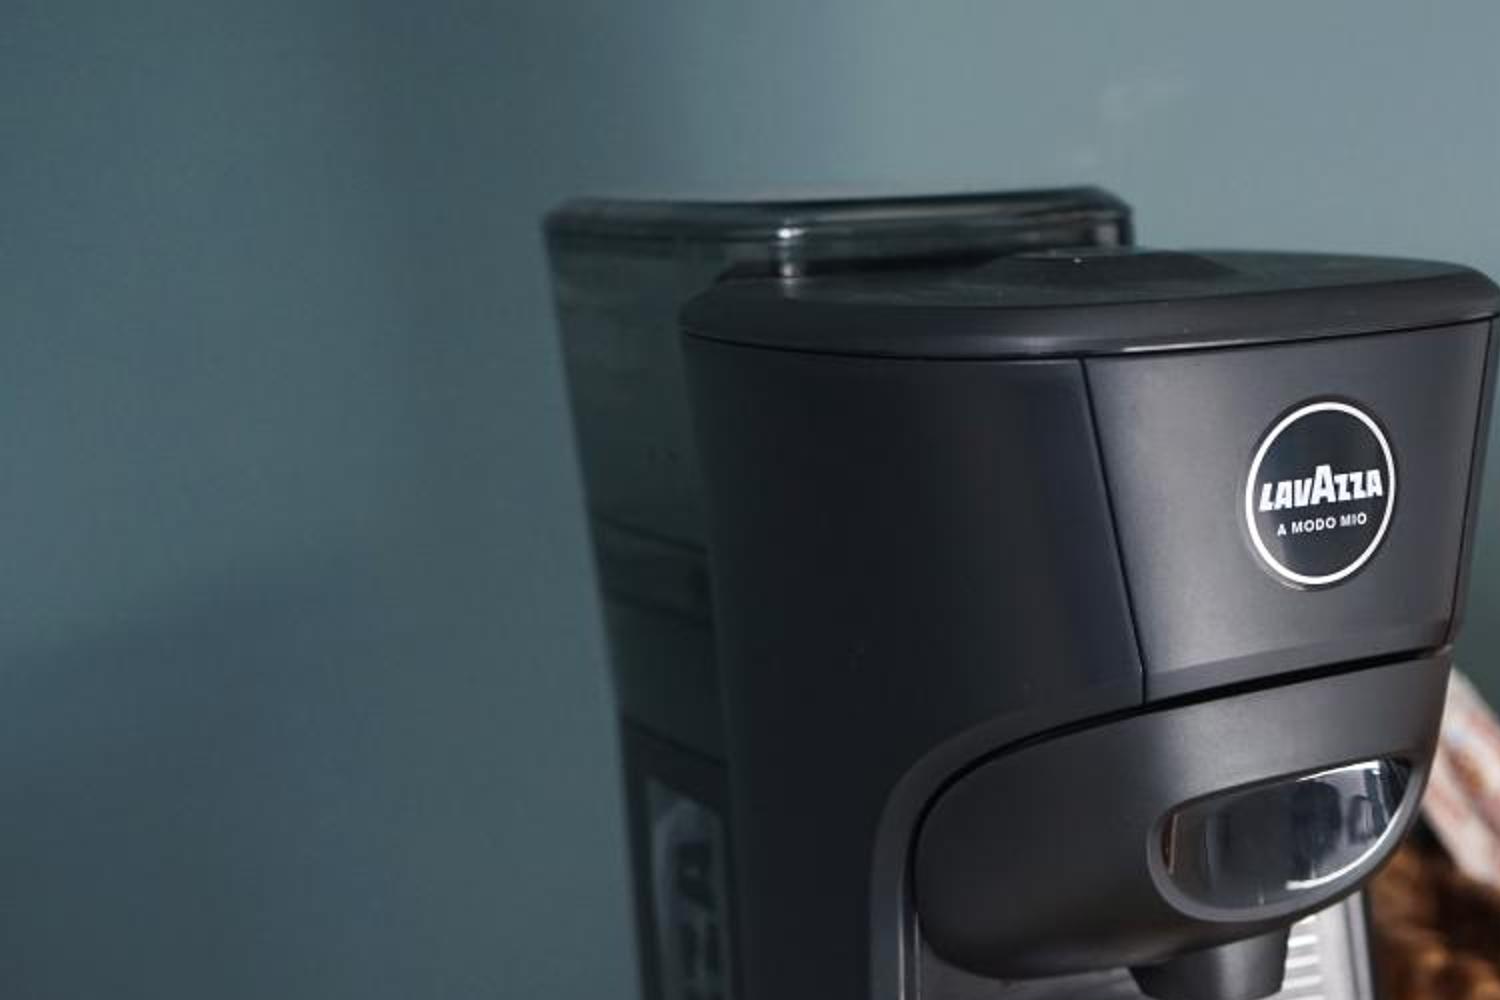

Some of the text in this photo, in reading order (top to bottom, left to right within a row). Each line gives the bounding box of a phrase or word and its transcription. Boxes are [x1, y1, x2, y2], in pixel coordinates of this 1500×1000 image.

[1259, 464, 1384, 512] LAVAZZA
[1276, 511, 1368, 537] A MODO MIO
